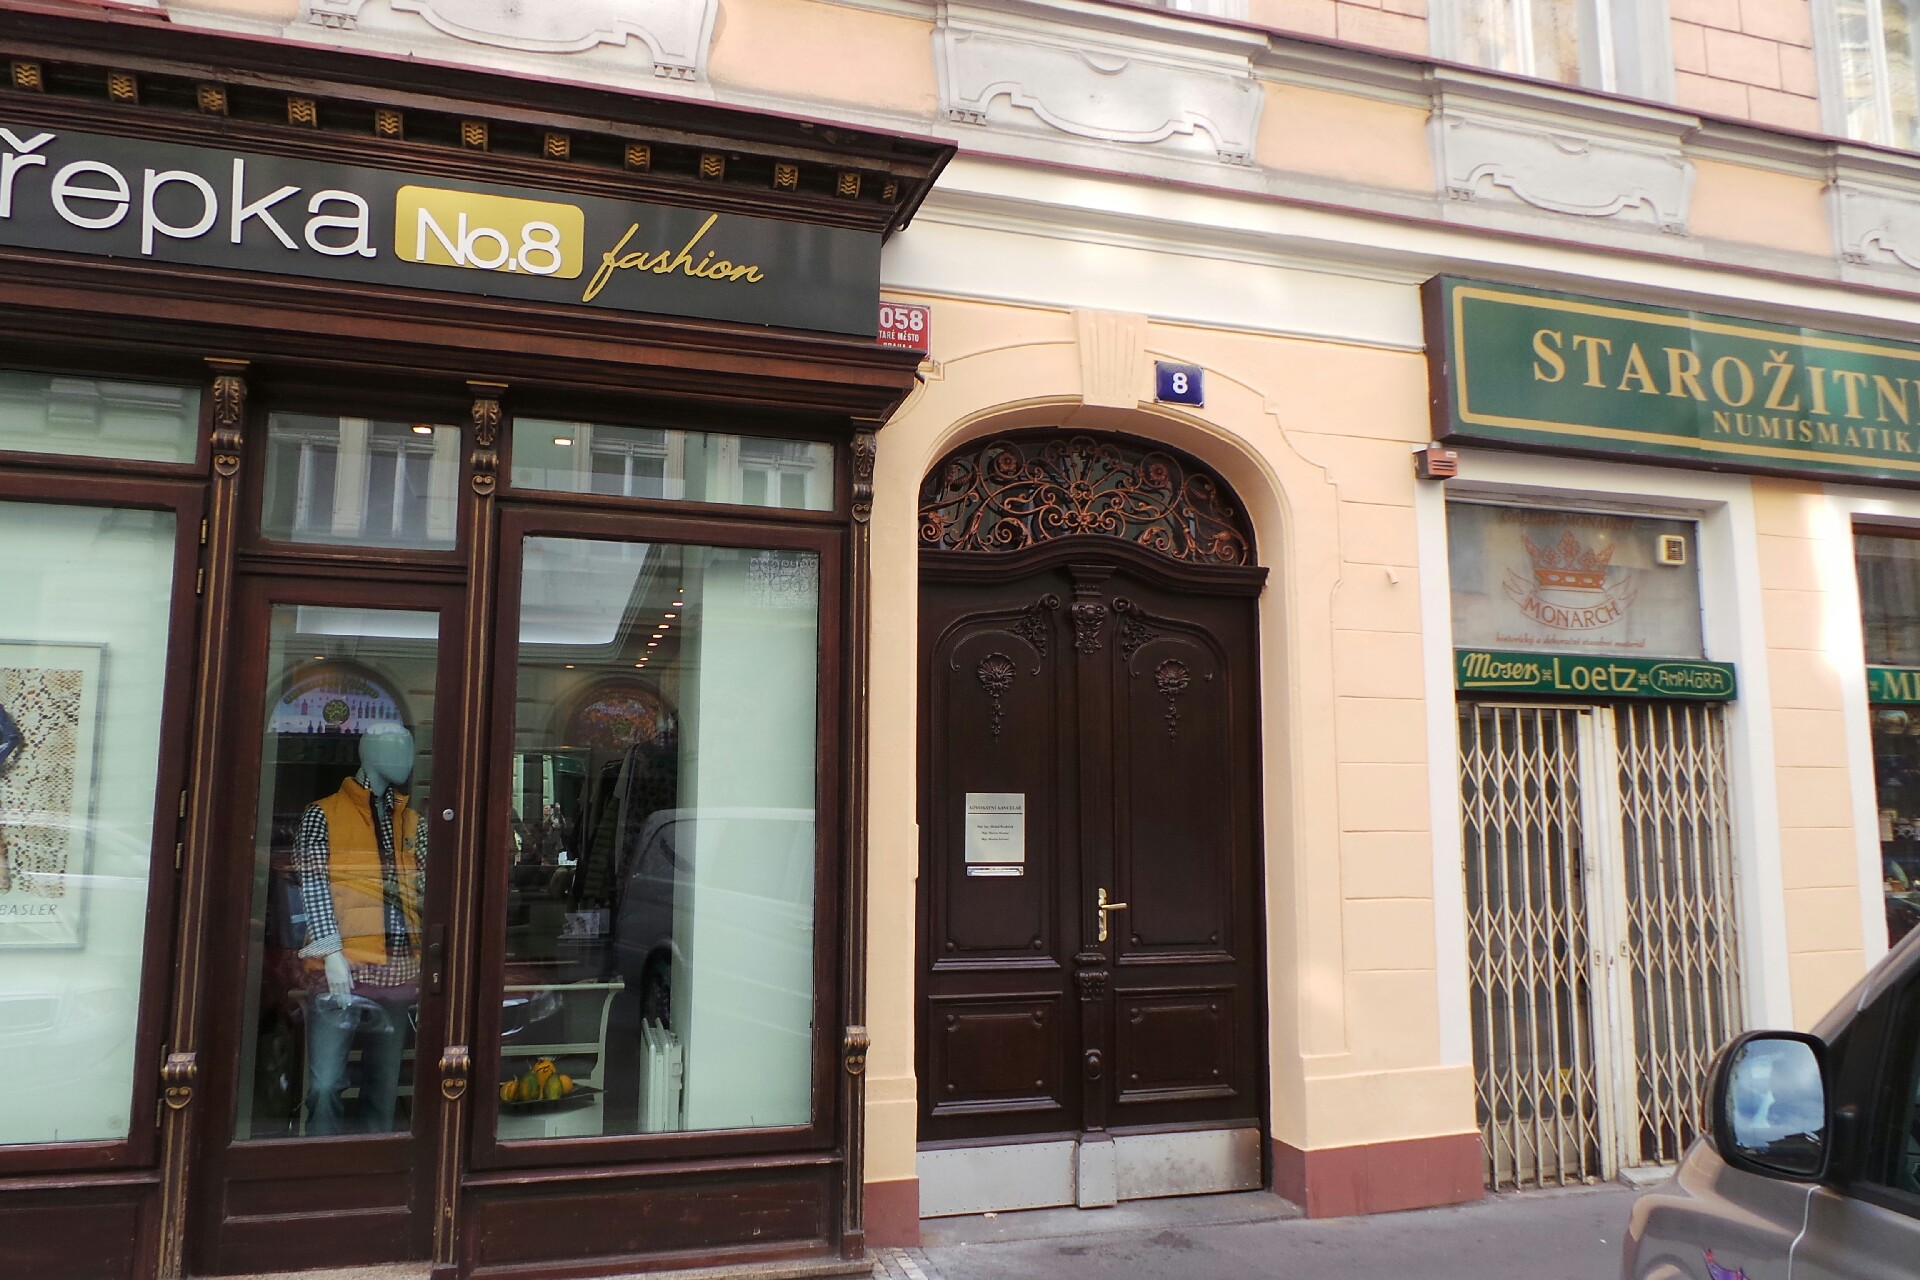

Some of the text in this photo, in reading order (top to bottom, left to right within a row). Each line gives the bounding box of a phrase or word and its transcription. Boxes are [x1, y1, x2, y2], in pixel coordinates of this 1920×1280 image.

[415, 206, 562, 275] No.8
[582, 213, 765, 302] fashion
[1172, 372, 1188, 394] 8
[1713, 410, 1920, 454] NUMISMATIK
[1524, 597, 1621, 628] MONARCH
[1553, 656, 1639, 692] Loetz
[0, 903, 58, 916] BASLER
